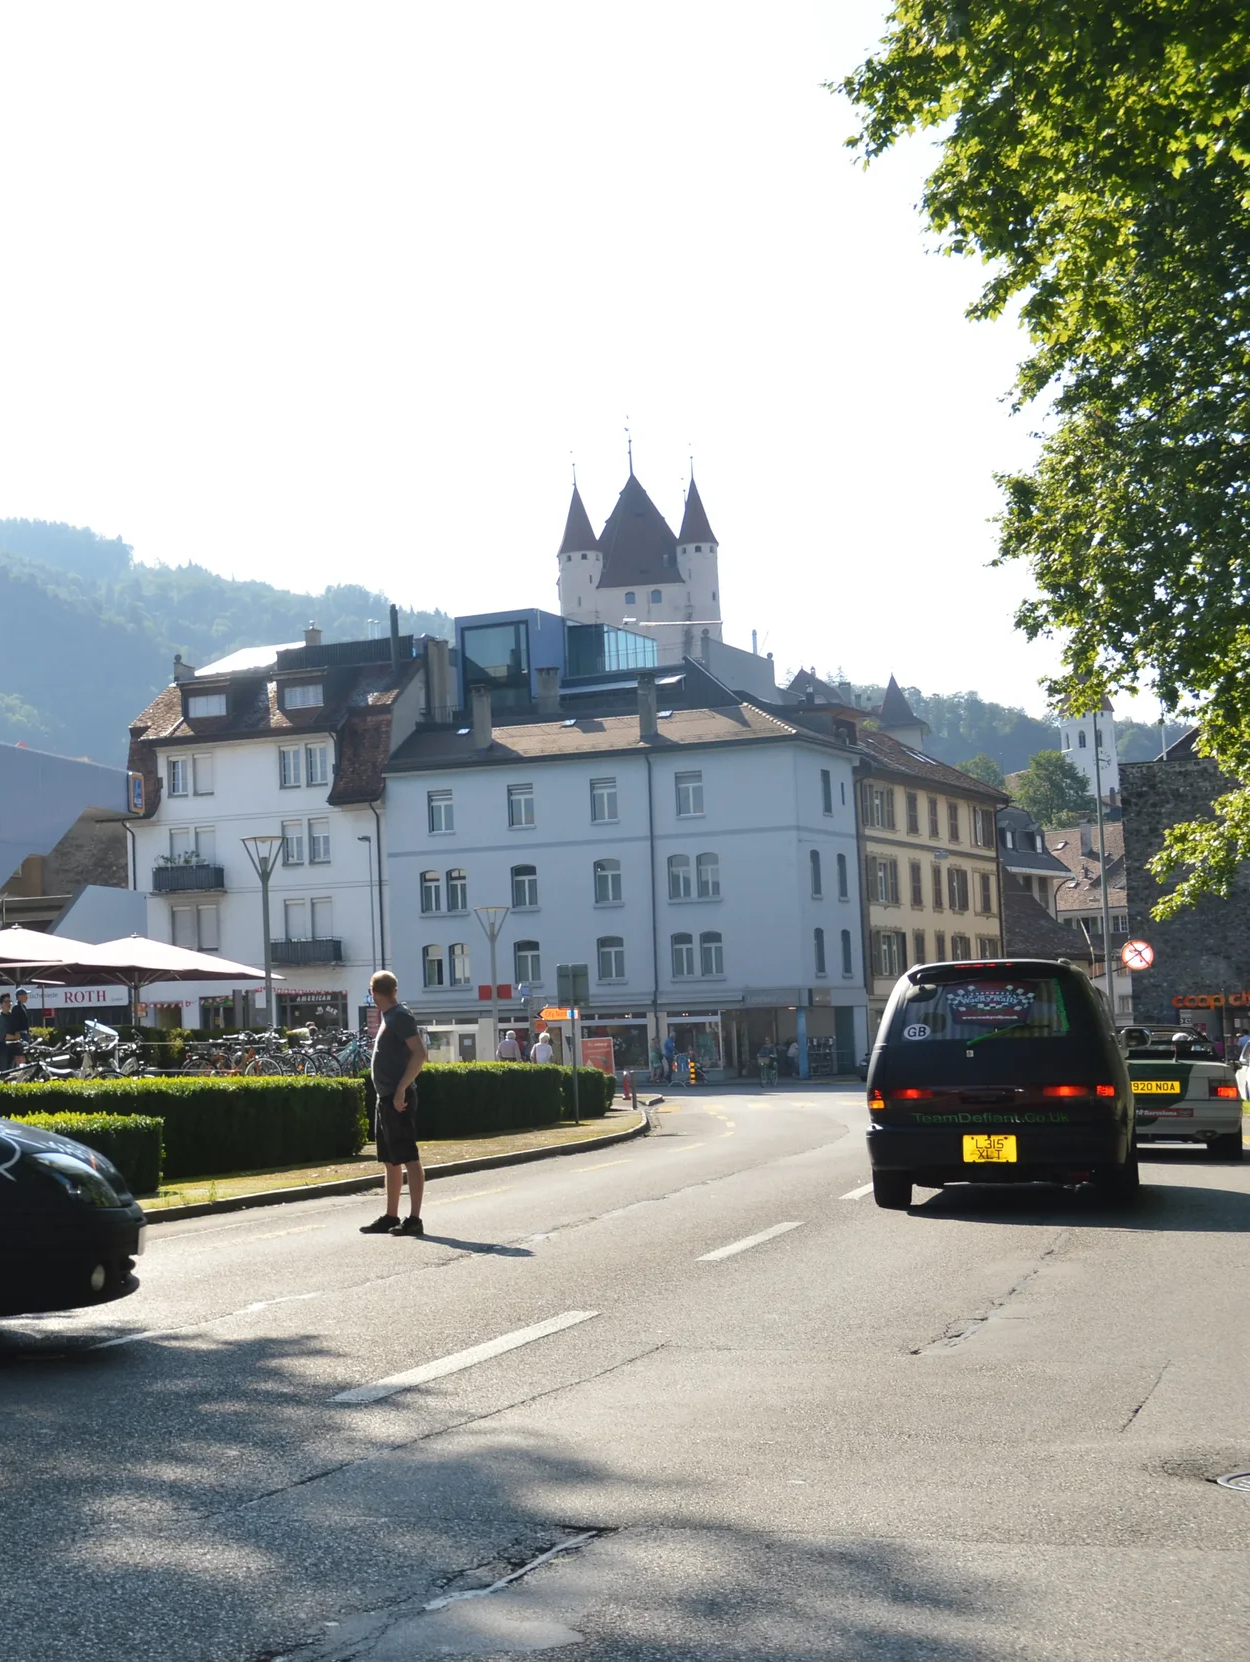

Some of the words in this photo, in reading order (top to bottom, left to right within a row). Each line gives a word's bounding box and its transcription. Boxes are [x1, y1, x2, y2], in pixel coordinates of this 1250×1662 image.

[64, 990, 106, 1003] ROTH
[1172, 994, 1225, 1010] coop
[325, 1005, 338, 1015] BAR
[907, 1026, 926, 1038] GB
[1132, 1082, 1152, 1091] 920
[1155, 1082, 1175, 1091] NOA
[912, 1113, 1069, 1123] TeamDefiant.Co.Uk
[975, 1139, 1004, 1149] L315
[977, 1149, 1002, 1160] XLT
